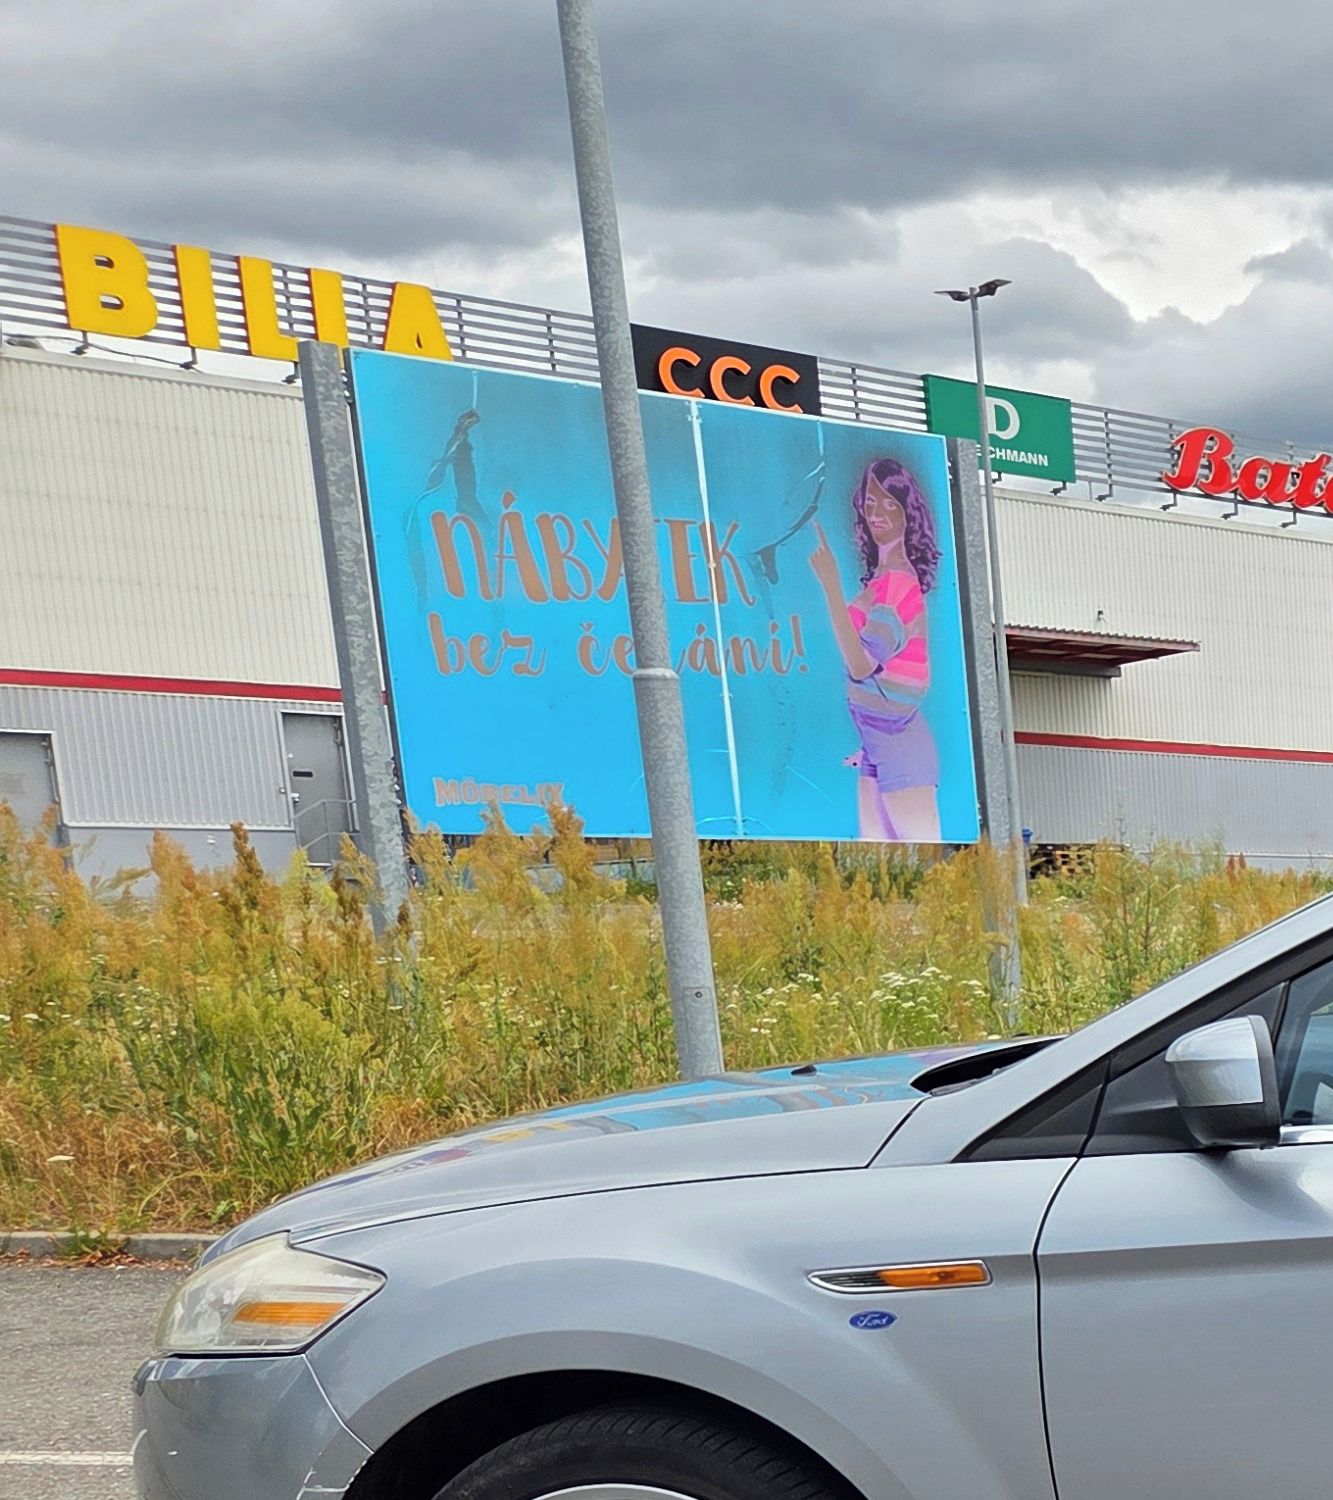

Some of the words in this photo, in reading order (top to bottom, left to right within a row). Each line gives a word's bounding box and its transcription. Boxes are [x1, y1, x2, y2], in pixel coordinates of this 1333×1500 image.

[658, 347, 804, 413] CCC
[985, 395, 1020, 440] D
[430, 490, 756, 606] NÁBYEK
[428, 612, 547, 677] bez
[578, 613, 809, 677] čeání!
[857, 1313, 889, 1327] Ford
